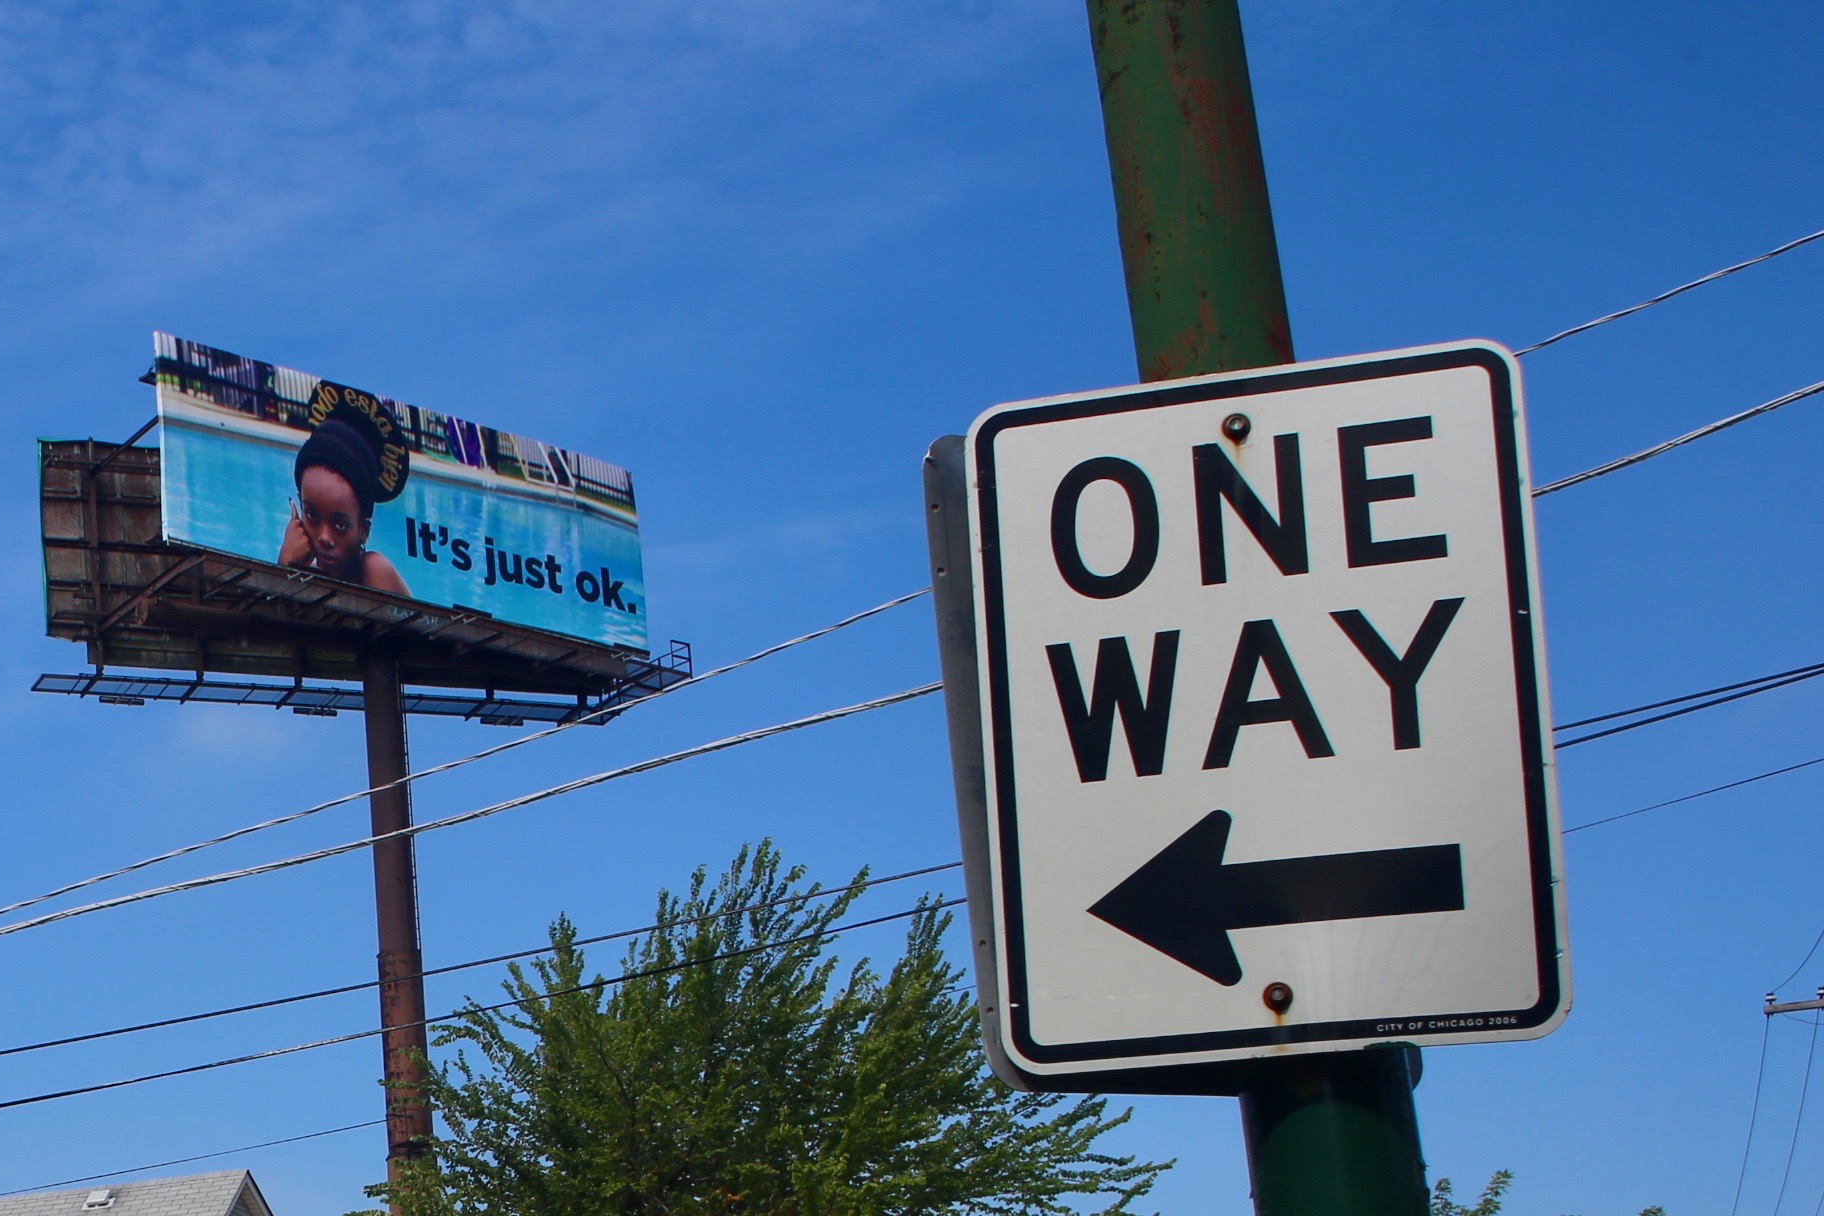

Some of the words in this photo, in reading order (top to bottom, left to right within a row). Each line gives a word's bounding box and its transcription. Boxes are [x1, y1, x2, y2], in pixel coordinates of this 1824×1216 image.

[378, 443, 405, 492] bien
[1050, 415, 1448, 599] ONE
[405, 517, 471, 572] It's
[483, 537, 563, 594] just
[575, 566, 637, 614] ok.
[1045, 597, 1465, 783] WAY
[1377, 1023, 1403, 1032] CITY
[1408, 1022, 1423, 1030] OF
[1428, 1018, 1484, 1028] CHICAGO
[1488, 1016, 1517, 1025] 2006
